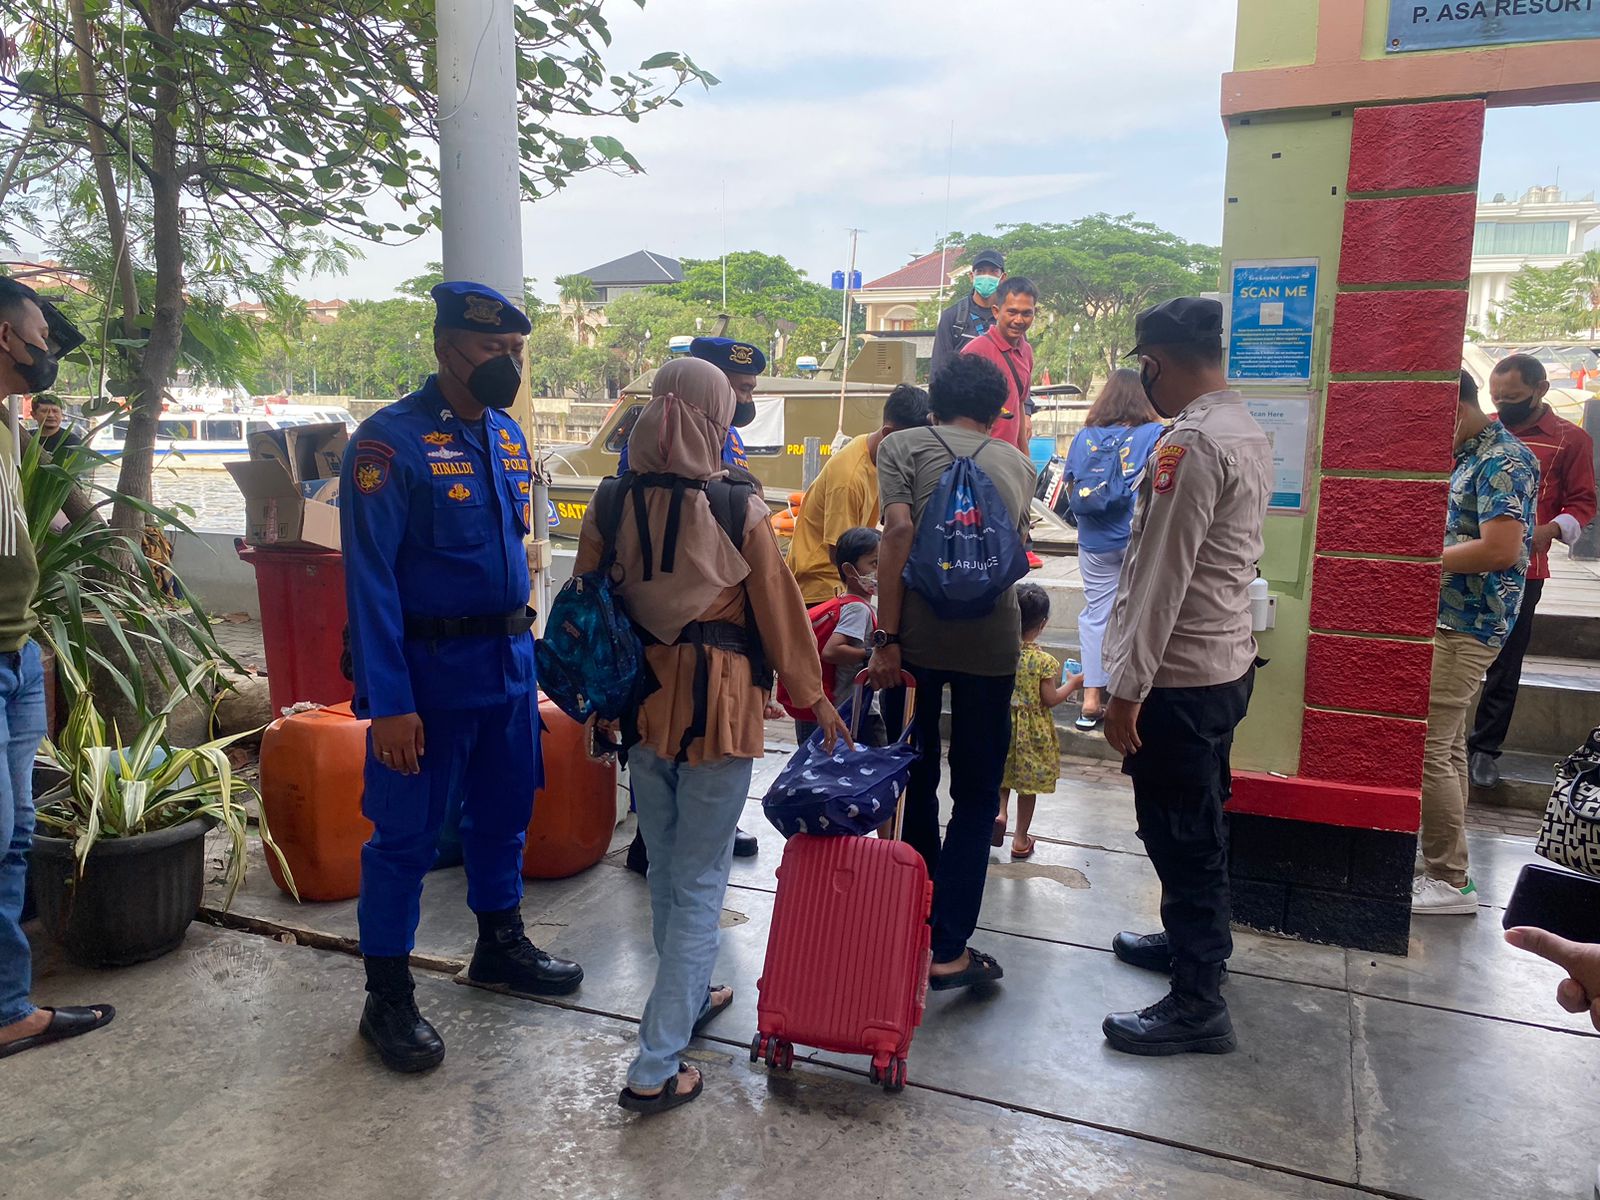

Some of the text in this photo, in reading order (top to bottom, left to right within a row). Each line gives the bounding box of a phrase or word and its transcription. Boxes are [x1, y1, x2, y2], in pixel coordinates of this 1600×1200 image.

[1412, 0, 1594, 23] P. ASA RESORT
[1240, 285, 1308, 298] SCAN ME
[430, 462, 474, 475] RINALDI
